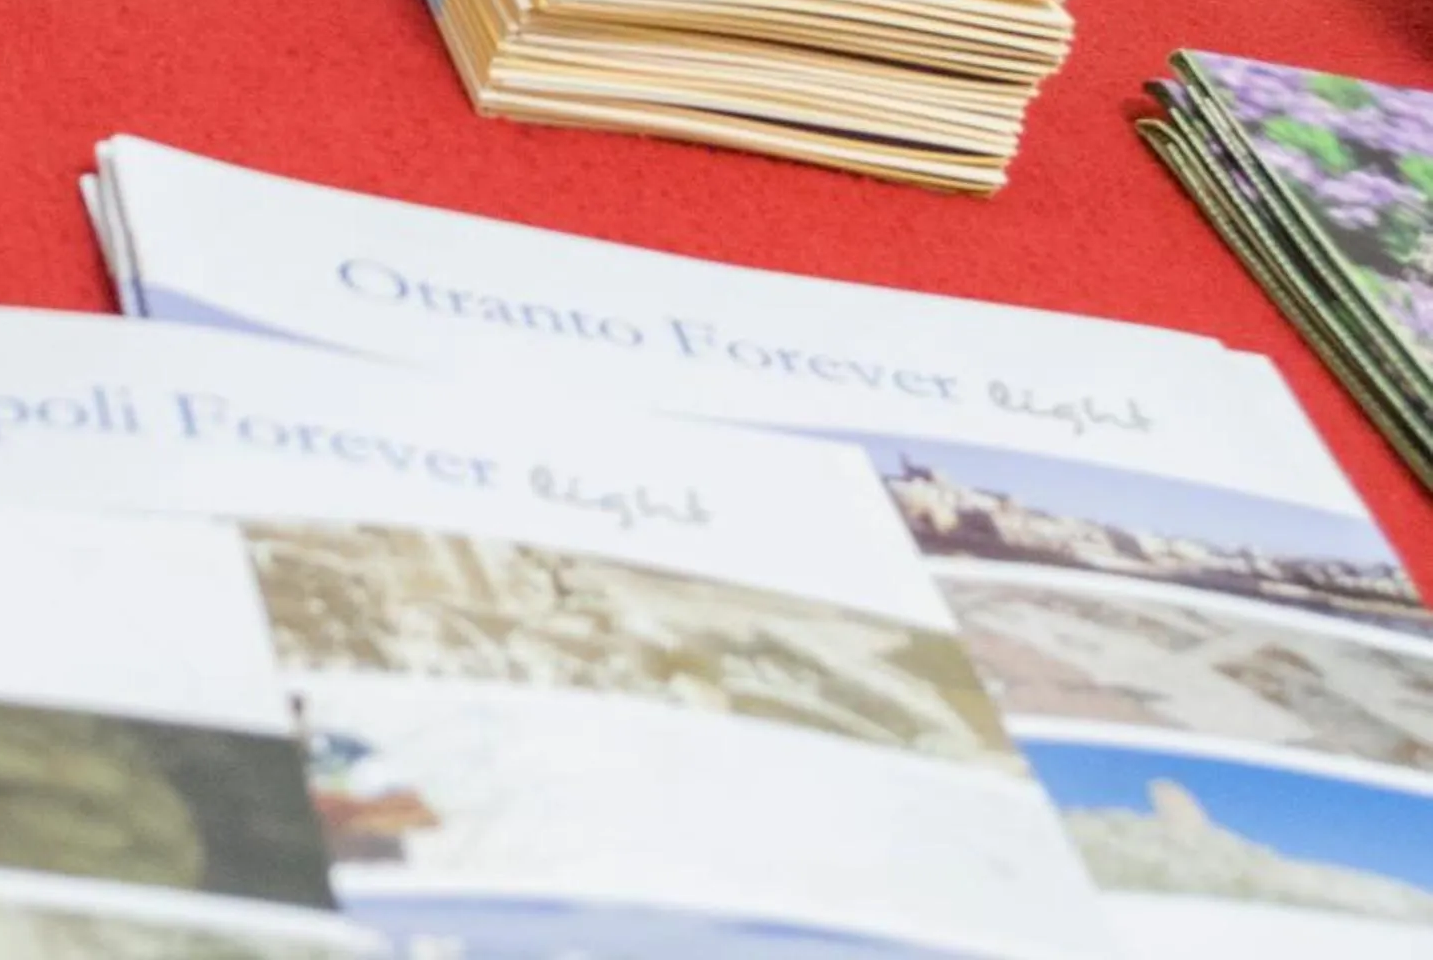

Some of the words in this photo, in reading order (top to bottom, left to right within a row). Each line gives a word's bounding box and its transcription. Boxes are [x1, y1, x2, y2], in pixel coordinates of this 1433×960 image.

[335, 257, 644, 345] Otranto
[665, 315, 963, 403] Forever
[987, 380, 1155, 437] light
[172, 389, 500, 487] Forever
[528, 463, 714, 529] light
